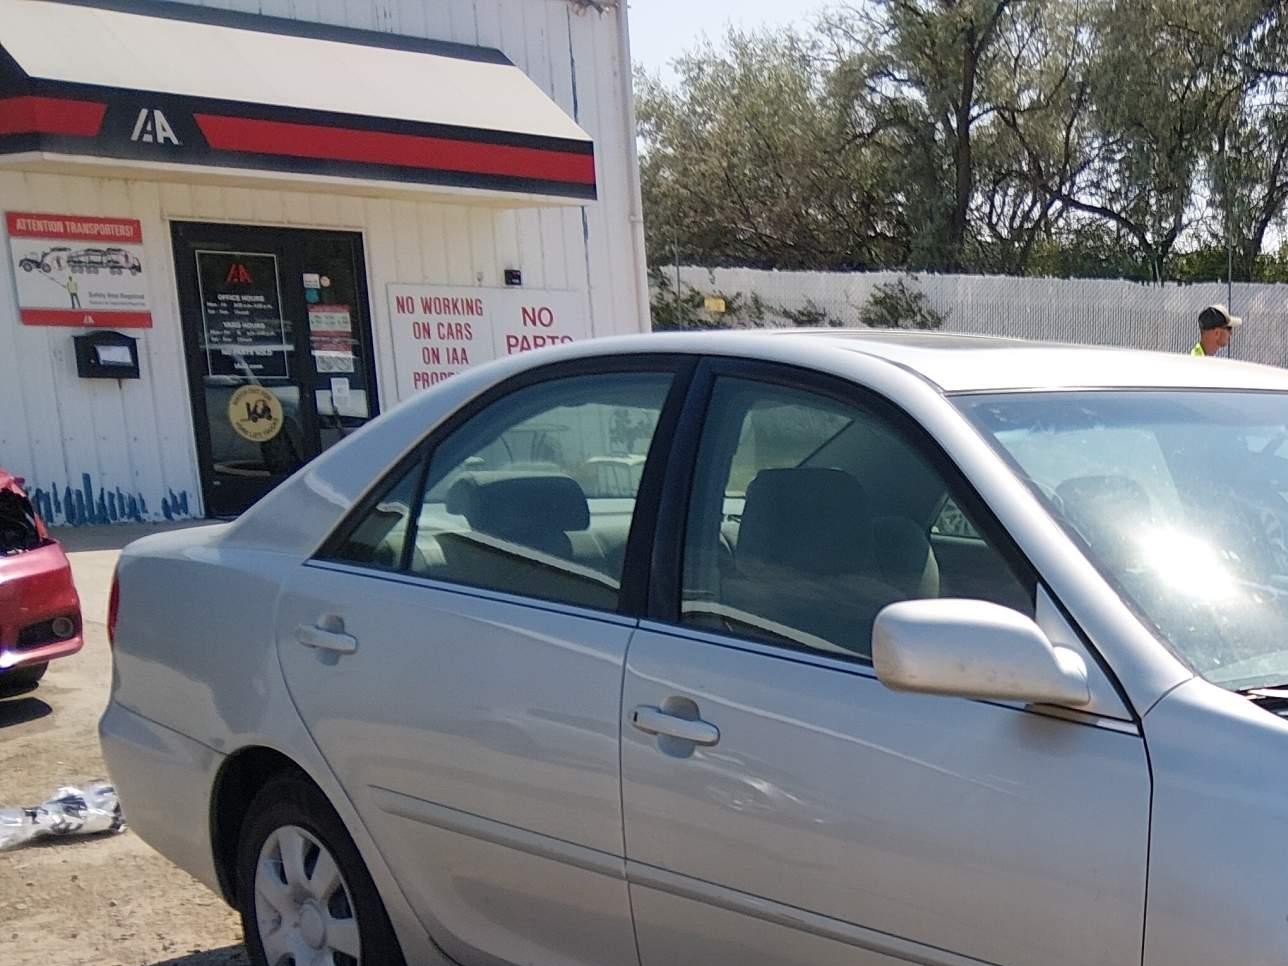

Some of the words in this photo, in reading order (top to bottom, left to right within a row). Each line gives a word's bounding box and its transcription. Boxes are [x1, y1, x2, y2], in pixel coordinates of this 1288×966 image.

[16, 218, 64, 233] ATTENTION
[66, 221, 134, 237] TRANSPORTERS!
[396, 296, 414, 314] NO
[420, 296, 483, 317] WORKING
[521, 306, 554, 328] NO
[412, 322, 431, 340] ON
[437, 322, 473, 341] CARS
[422, 346, 440, 365] ON
[446, 347, 469, 365] IAA
[413, 371, 457, 389] PROP
